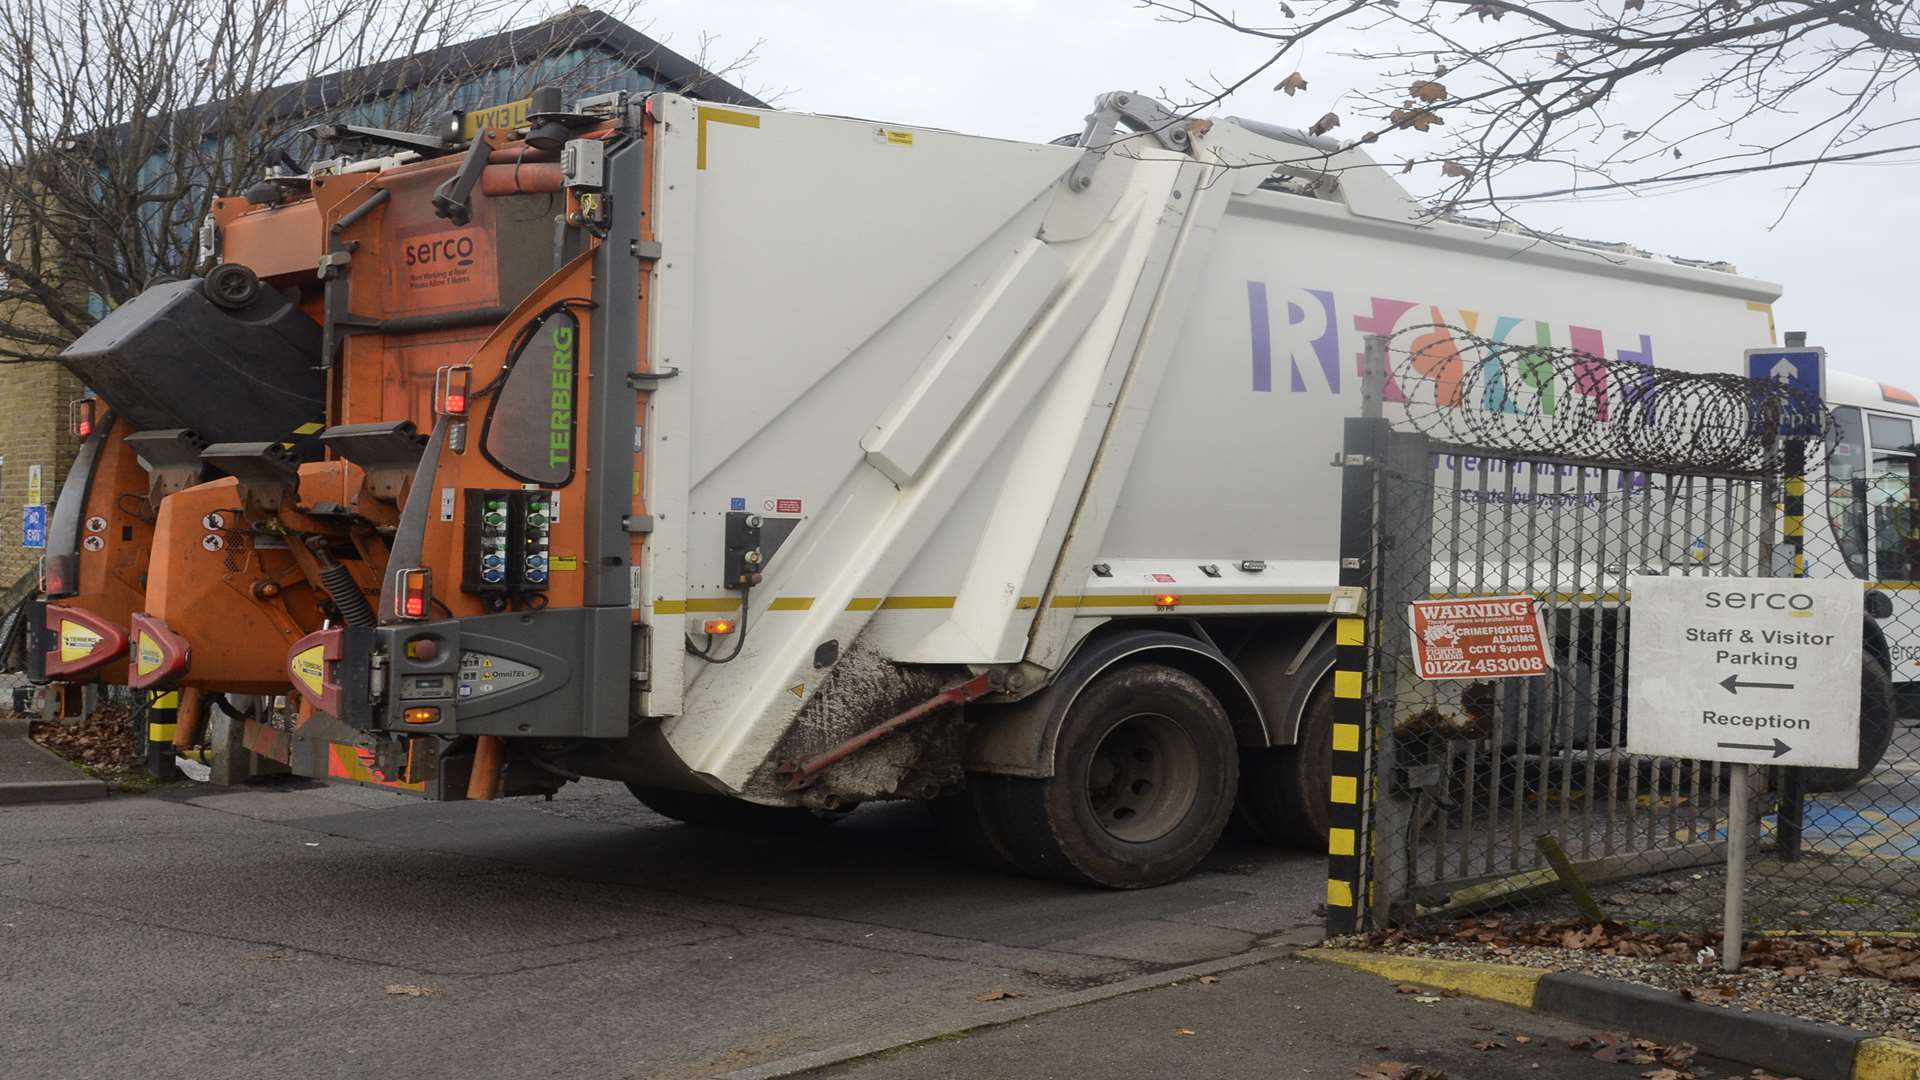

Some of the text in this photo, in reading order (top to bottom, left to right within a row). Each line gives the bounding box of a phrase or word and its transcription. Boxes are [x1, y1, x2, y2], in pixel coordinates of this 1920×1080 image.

[476, 108, 510, 129] VX13
[406, 236, 474, 266] serco
[550, 327, 573, 469] TERBERG
[1419, 601, 1528, 620] WARNING
[1705, 591, 1814, 611] serco
[1456, 625, 1534, 636] CRIMEFIGHTER
[1492, 634, 1536, 644] ALARMS
[1686, 627, 1835, 647] Staff & Visitor
[1468, 645, 1538, 655] CCTV System
[1716, 650, 1798, 670] Parking
[492, 670, 526, 679] OmniTEL
[1424, 657, 1544, 675] 01227-453008
[1703, 710, 1811, 731] Reception
